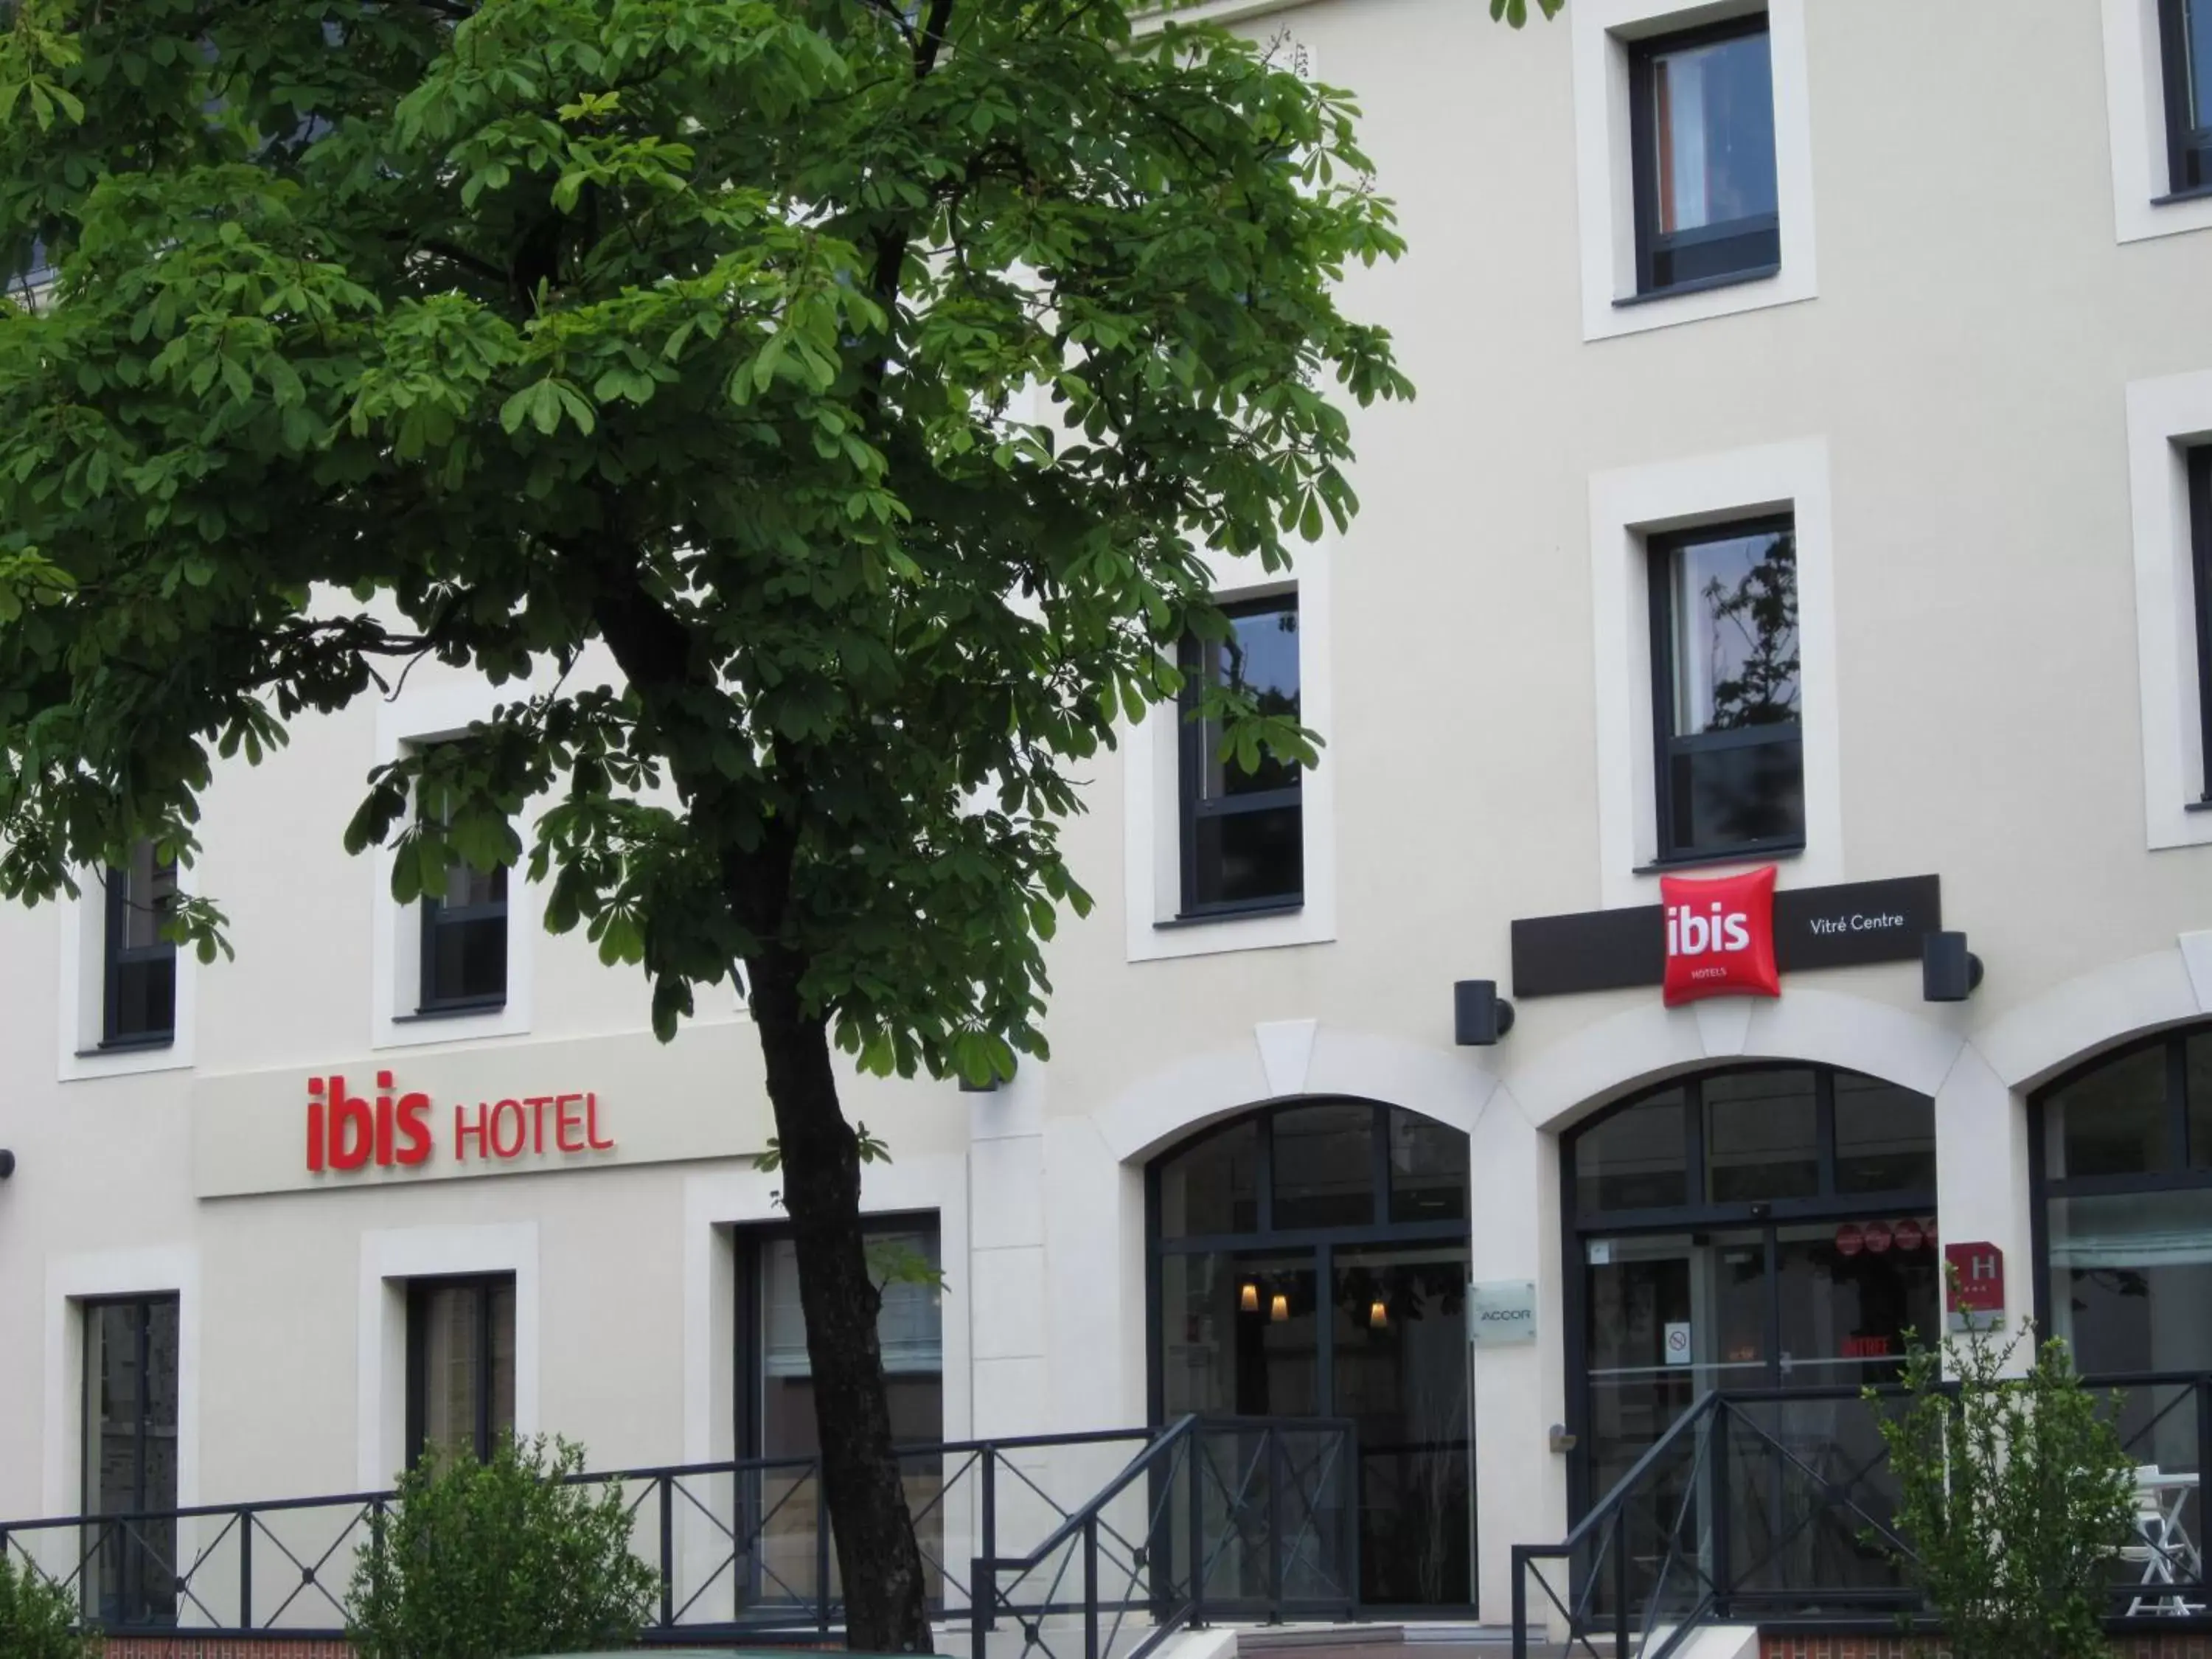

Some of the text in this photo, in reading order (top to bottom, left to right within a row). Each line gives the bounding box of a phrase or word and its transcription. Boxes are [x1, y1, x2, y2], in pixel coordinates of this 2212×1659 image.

[1668, 902, 1750, 956] ibis
[1810, 911, 1904, 934] Vitré Centre
[1691, 967, 1727, 979] HOTELS
[306, 1071, 614, 1171] ibis HOTEL
[1972, 1255, 1994, 1280] H
[1481, 1310, 1531, 1321] ACCOR
